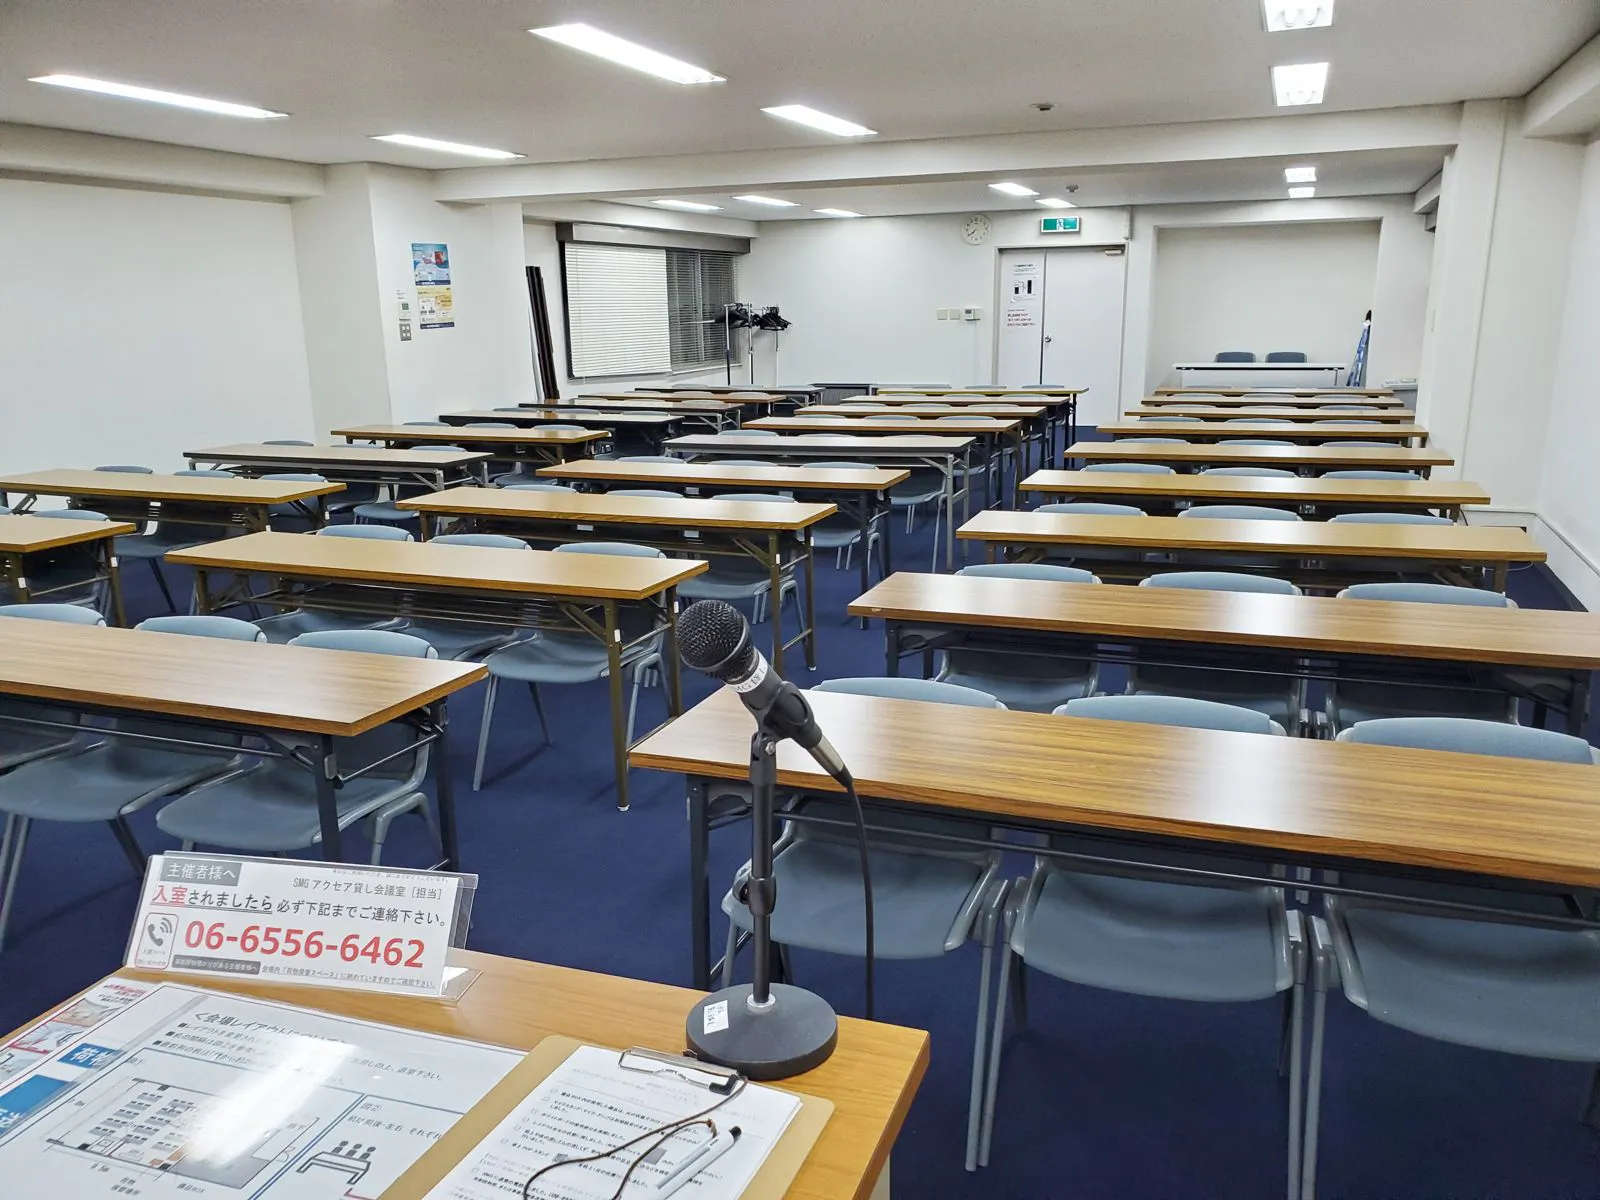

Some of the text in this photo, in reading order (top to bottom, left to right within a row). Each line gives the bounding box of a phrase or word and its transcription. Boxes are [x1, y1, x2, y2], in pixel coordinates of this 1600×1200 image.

[167, 862, 237, 881] 主催者様へ
[292, 877, 310, 889] SMG
[312, 879, 407, 897] アクセア貸し会議室
[151, 884, 447, 927] 入室されましたら 必ず下記までご連絡下さい。
[184, 920, 425, 968] 06-6556-6462
